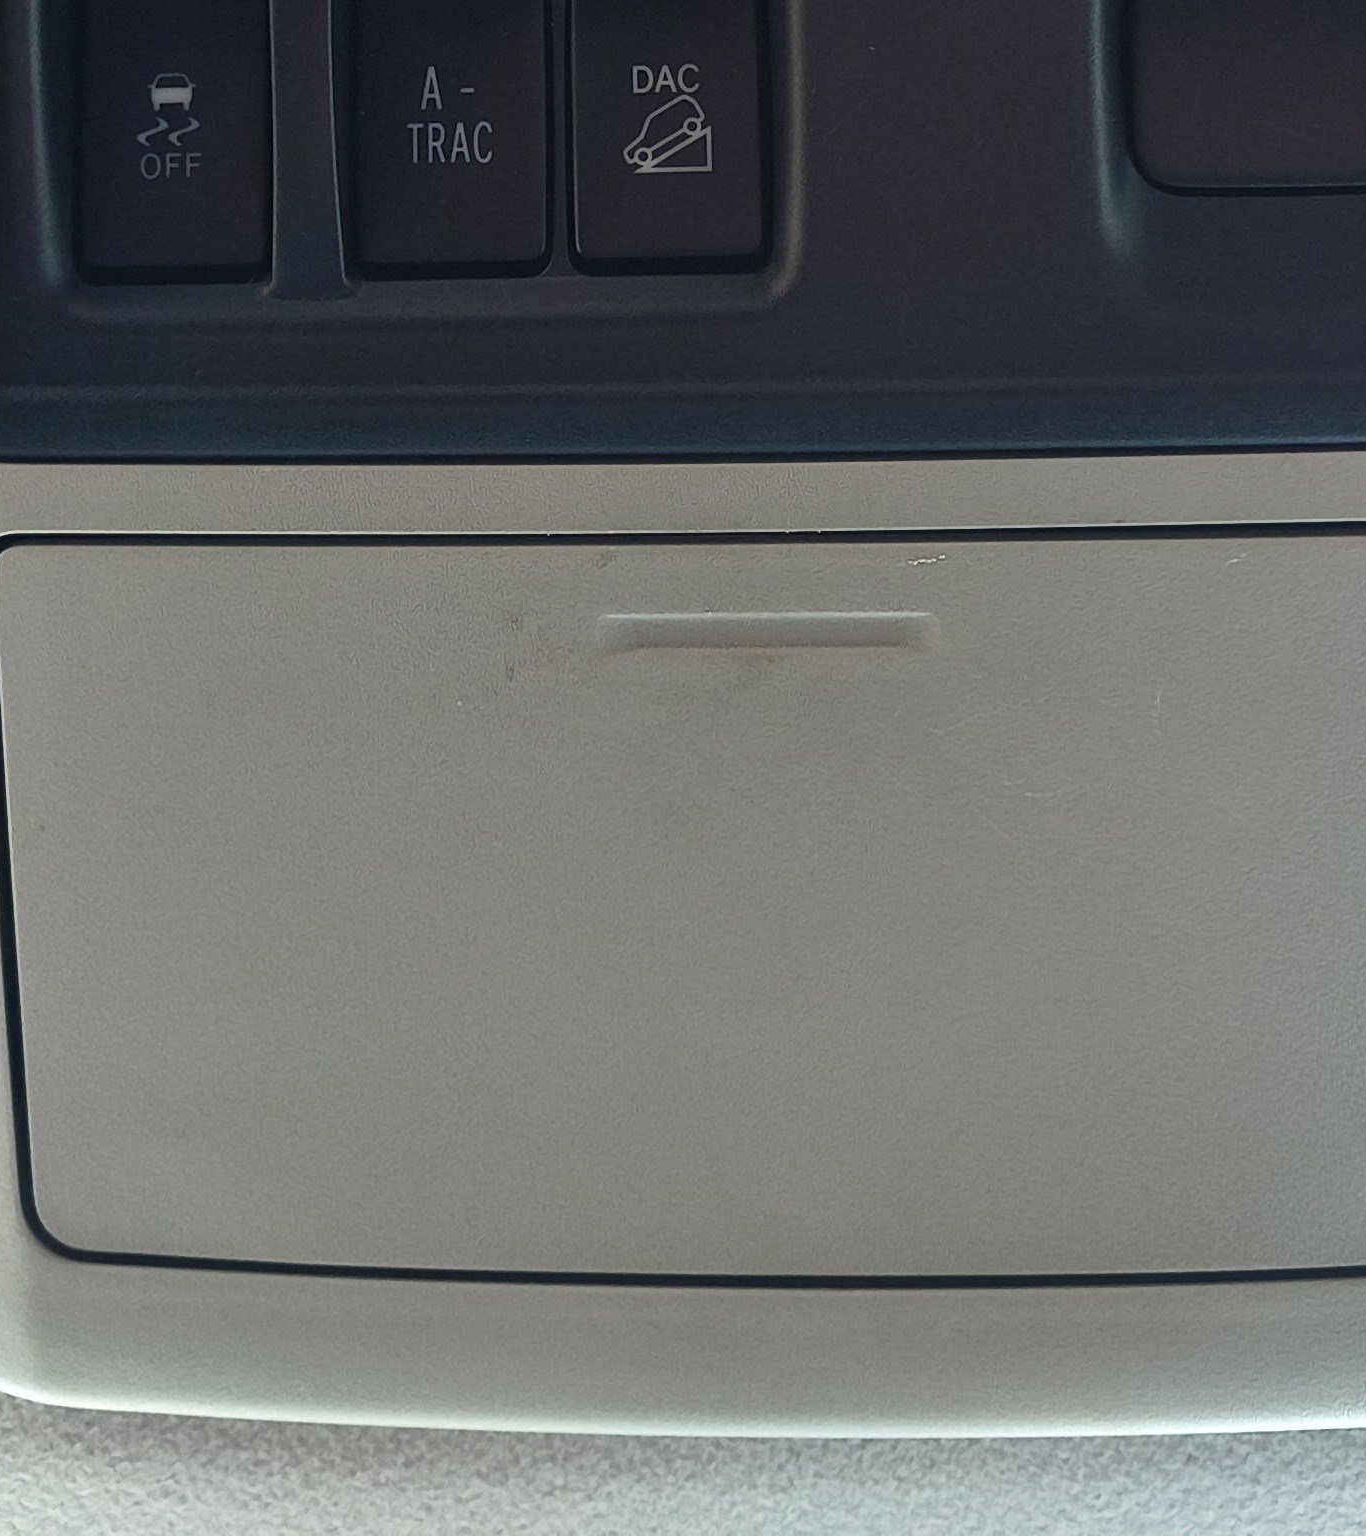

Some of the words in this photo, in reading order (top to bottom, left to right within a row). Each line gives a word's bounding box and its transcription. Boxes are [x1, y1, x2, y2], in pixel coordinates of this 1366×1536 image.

[420, 67, 442, 110] A
[632, 64, 700, 95] DAC
[407, 122, 494, 164] TRAC
[140, 153, 201, 180] OFF
